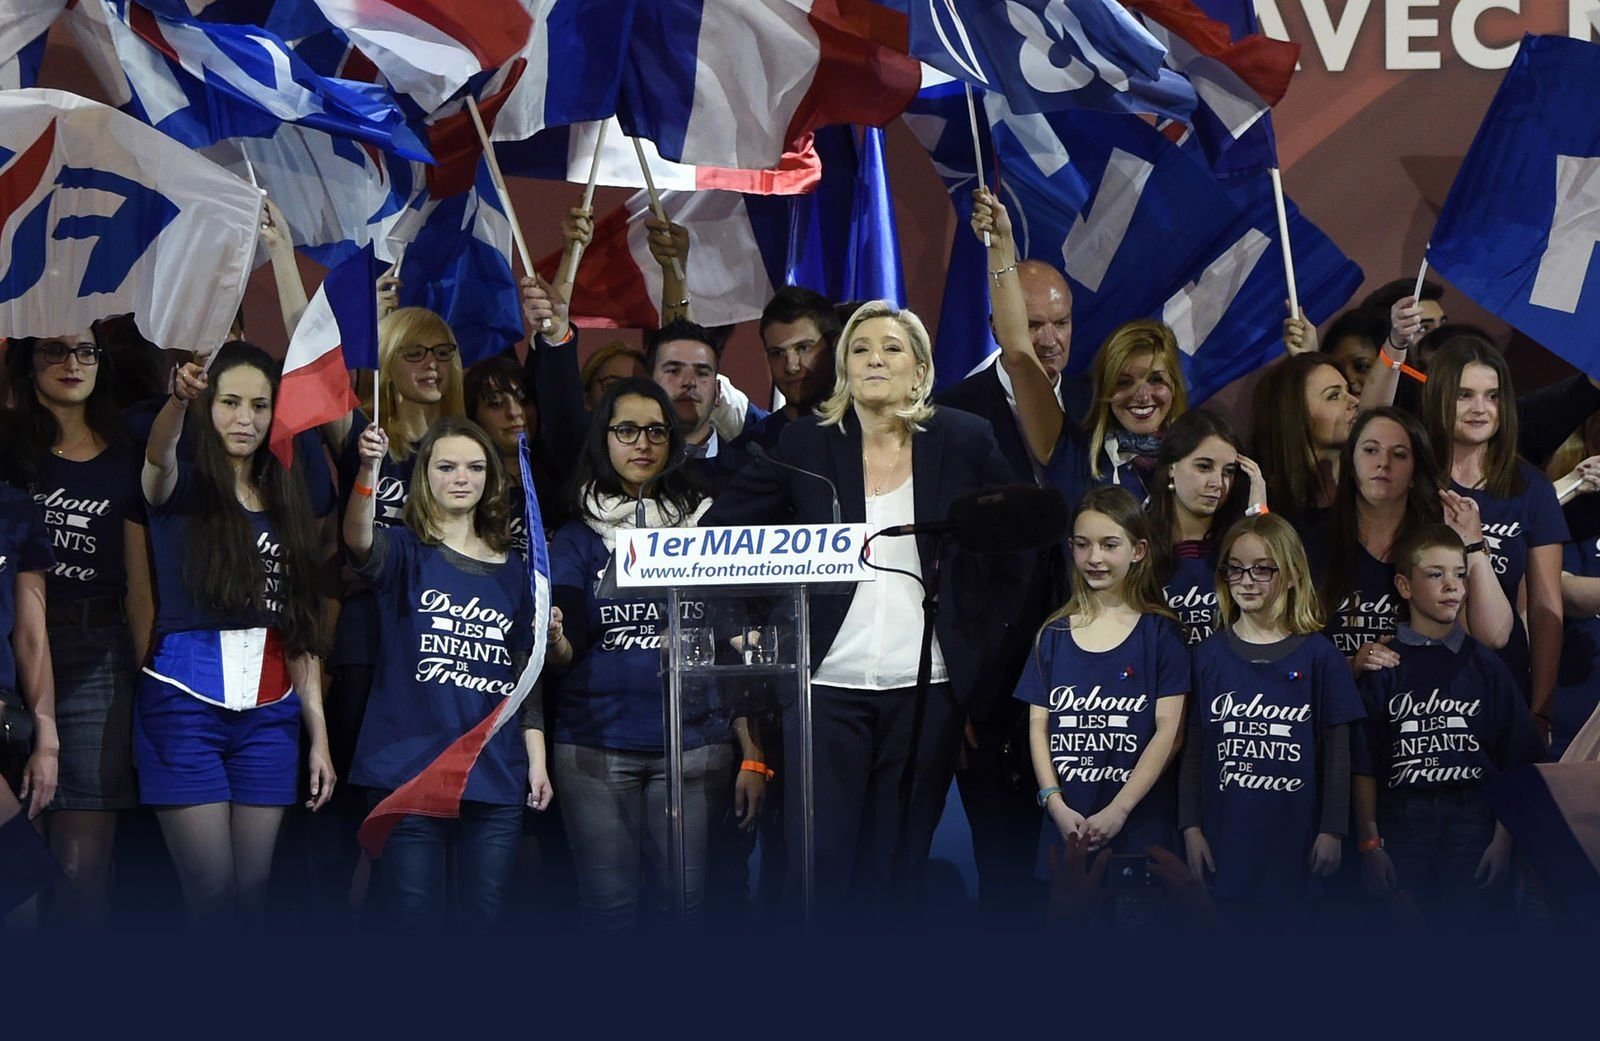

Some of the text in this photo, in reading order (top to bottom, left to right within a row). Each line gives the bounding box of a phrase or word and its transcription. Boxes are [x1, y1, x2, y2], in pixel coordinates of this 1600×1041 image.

[33, 487, 112, 517] ebout
[44, 510, 66, 526] ES
[647, 526, 852, 557] 1er MAI 2016
[640, 560, 854, 579] www.frontnational.com
[453, 621, 485, 639] LES
[639, 625, 656, 635] DE
[456, 661, 470, 672] DE
[415, 657, 516, 696] France
[1048, 685, 1149, 713] Debout
[1209, 690, 1313, 722] Debout
[1388, 687, 1482, 723] Debout
[1078, 714, 1107, 729] LES
[1238, 721, 1268, 736] LES
[1421, 715, 1447, 733] LES
[1050, 733, 1138, 753] ENFANTS
[1217, 738, 1301, 762] ENFANTS
[1080, 756, 1094, 766] DE
[1238, 762, 1253, 773] DE
[1424, 756, 1440, 767] DE
